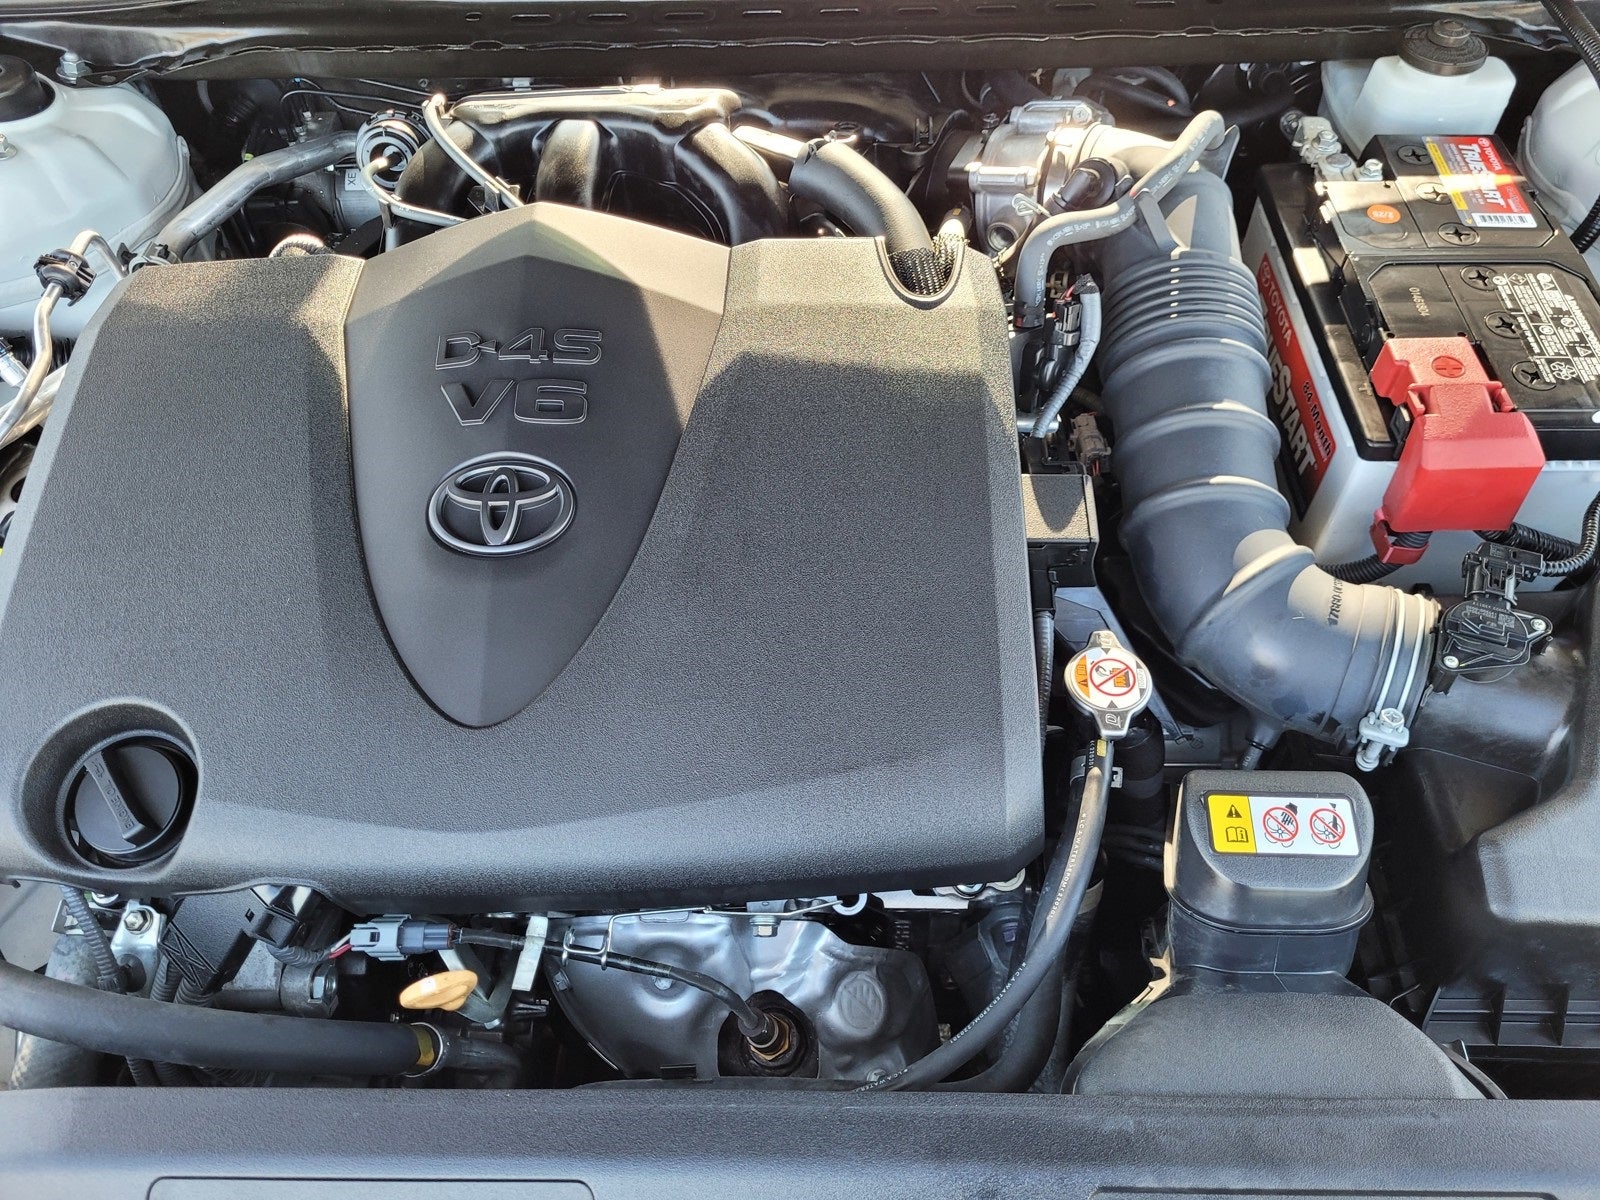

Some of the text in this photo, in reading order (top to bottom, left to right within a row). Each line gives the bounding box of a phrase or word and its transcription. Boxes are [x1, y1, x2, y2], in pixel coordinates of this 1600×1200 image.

[347, 172, 357, 186] XE
[1483, 147, 1502, 171] TOYOTA
[1269, 281, 1292, 347] TOYOTA
[440, 378, 588, 426] V6
[1302, 381, 1313, 403] 84
[1310, 404, 1331, 457] Month
[110, 794, 135, 829] ENGINE
